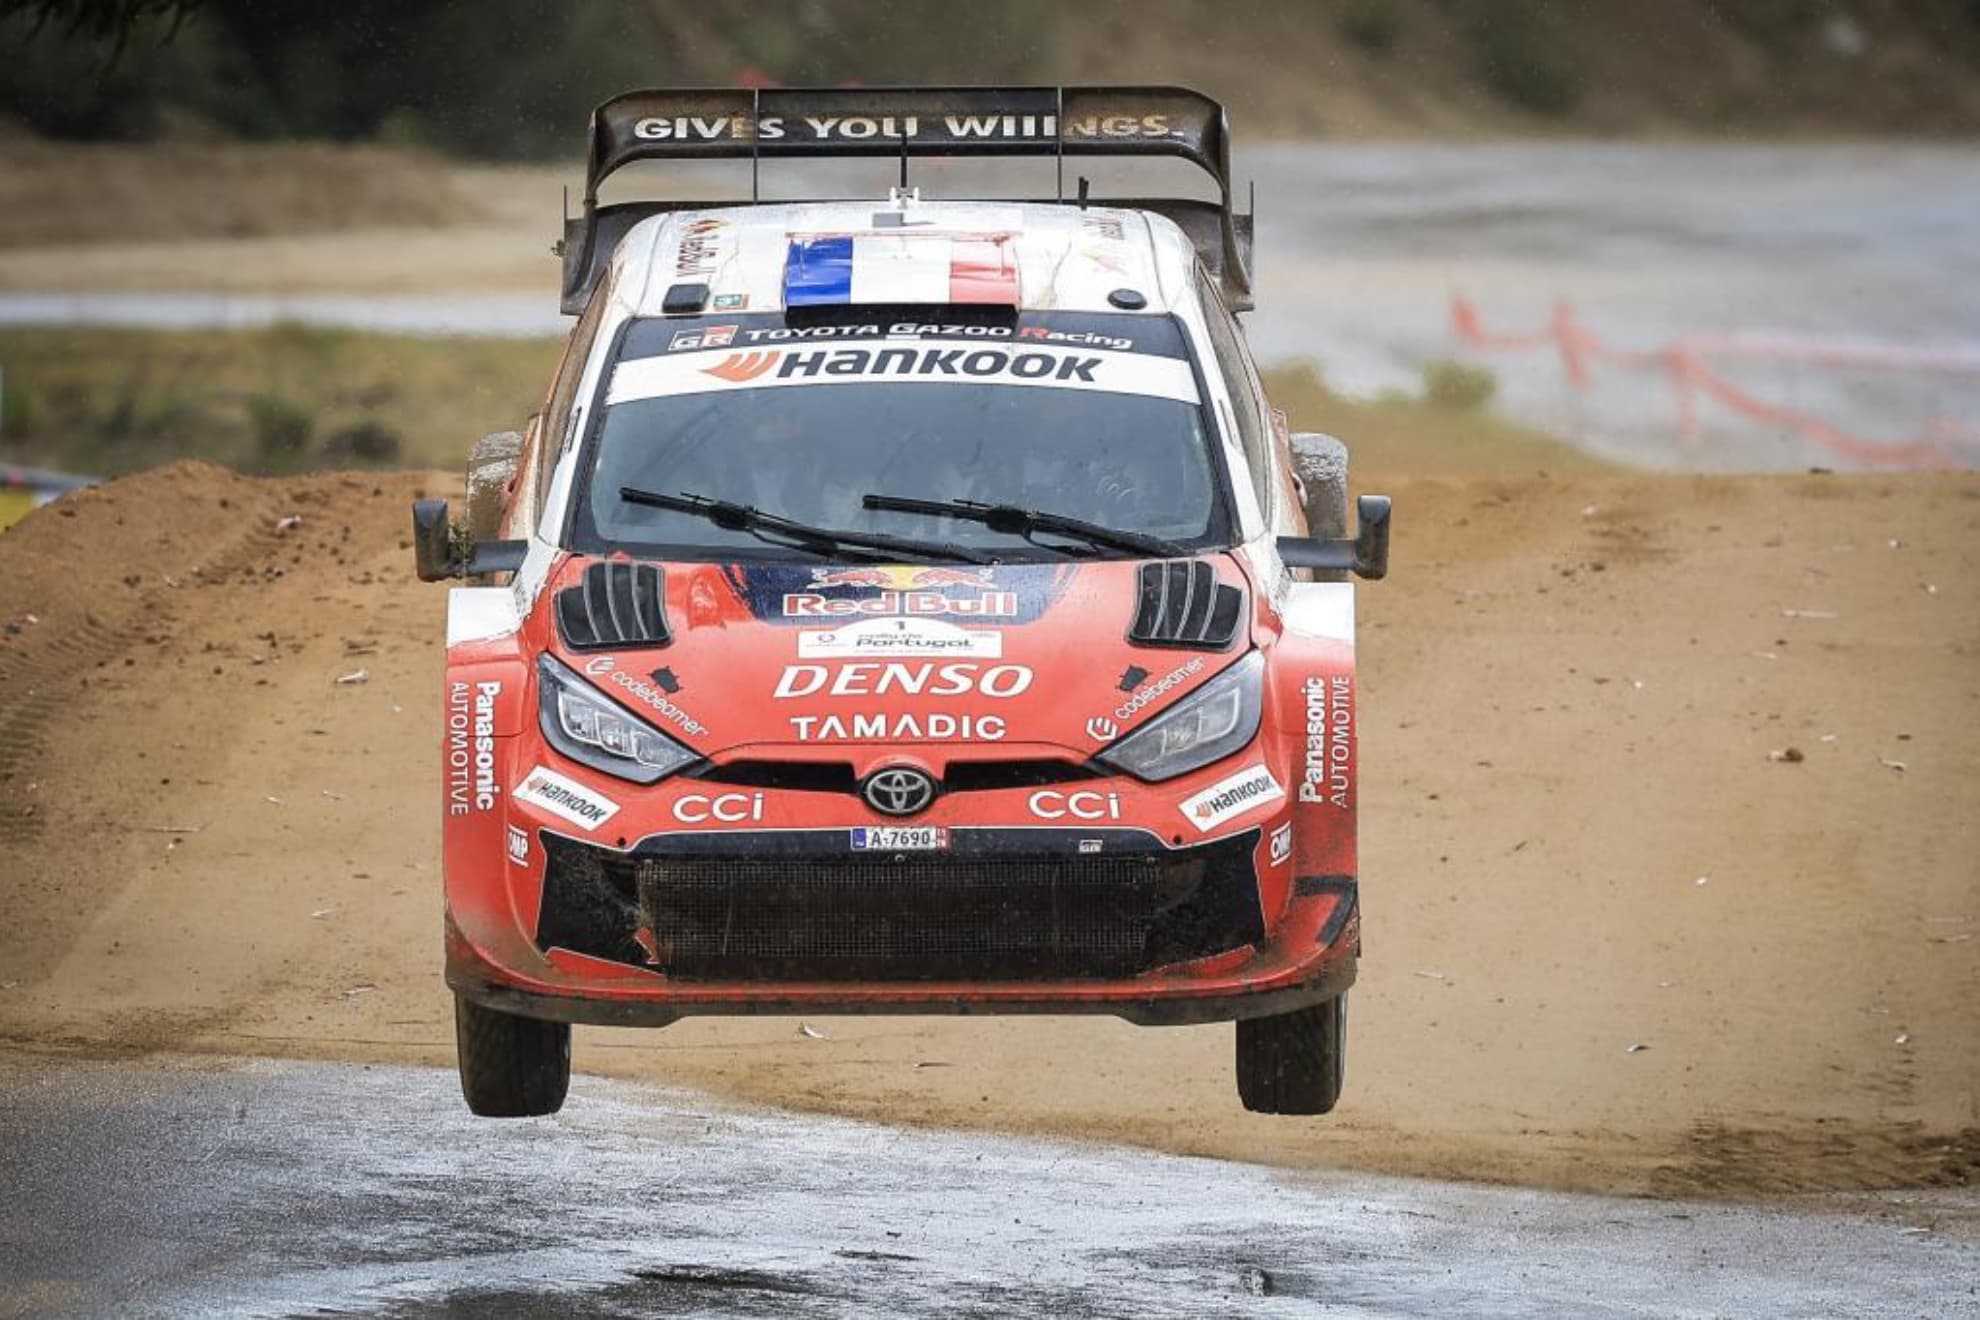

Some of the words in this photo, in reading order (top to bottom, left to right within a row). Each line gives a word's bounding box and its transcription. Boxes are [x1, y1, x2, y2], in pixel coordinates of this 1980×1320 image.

[634, 117, 786, 140] GIVES
[805, 116, 920, 139] YOU
[747, 325, 879, 341] TOYOTA
[888, 322, 1013, 336] GAZOO
[1020, 326, 1133, 349] Racing
[783, 591, 900, 616] Red
[905, 591, 1017, 616] Bull
[773, 663, 1034, 698] DENSO
[1115, 656, 1205, 720] codebeamer
[610, 671, 708, 736] codebeamer
[790, 714, 1006, 740] TAMADIC
[1299, 677, 1326, 803] Panasonic
[1330, 675, 1350, 809] AUTOMOTIVE
[450, 681, 469, 816] AUTOMOTIVE
[475, 681, 501, 811] Panasonic
[672, 793, 763, 822] CCi
[1028, 790, 1120, 819] CCi
